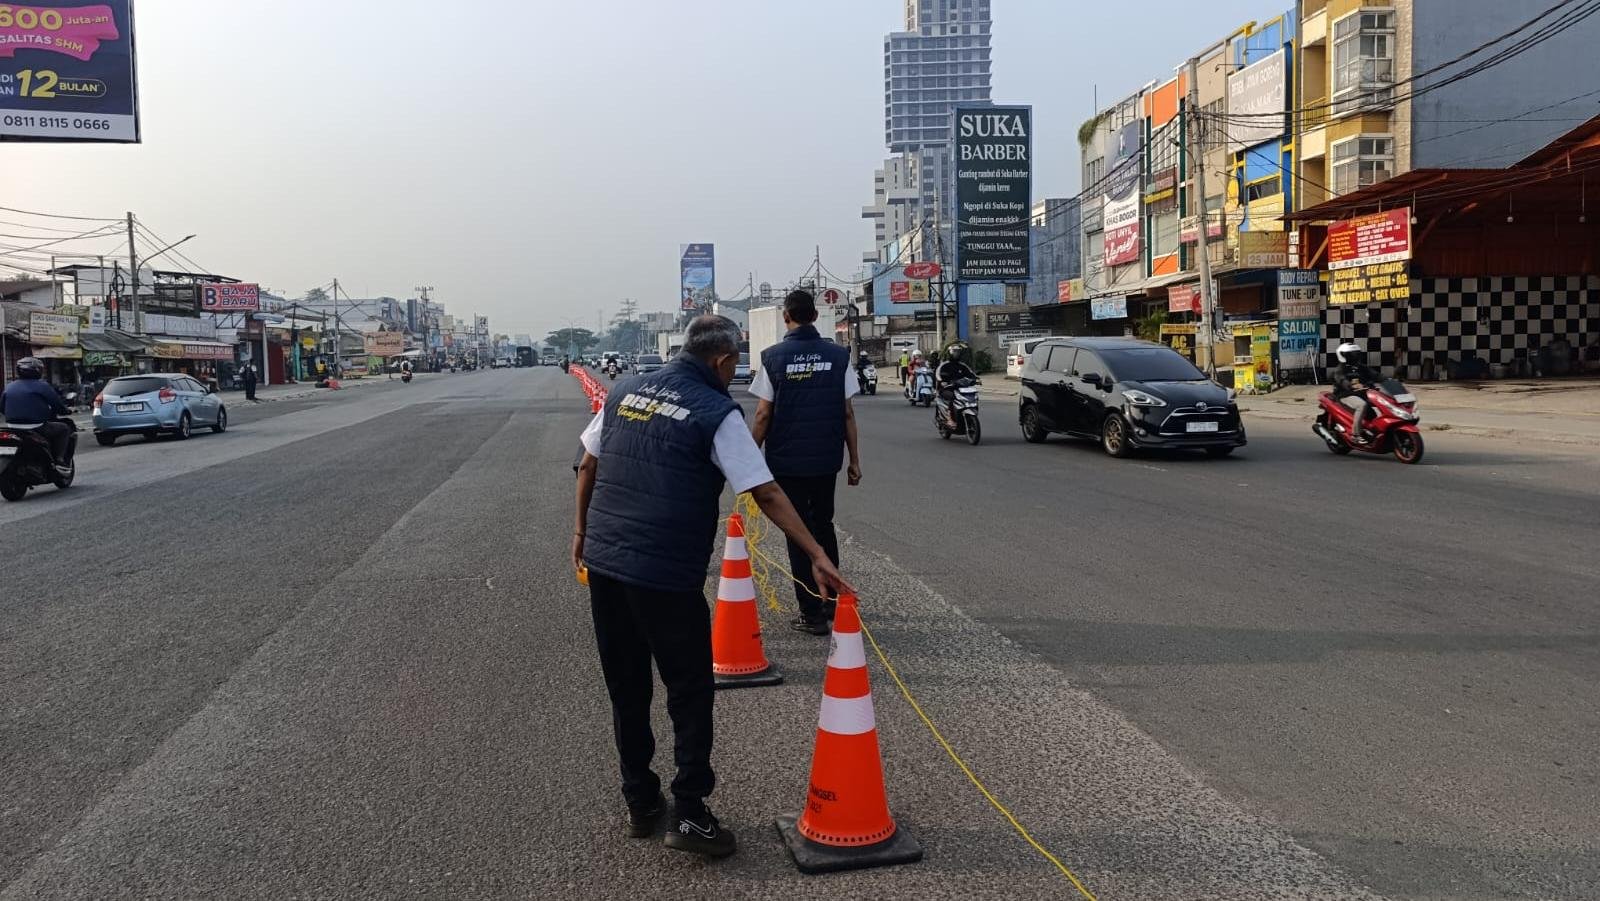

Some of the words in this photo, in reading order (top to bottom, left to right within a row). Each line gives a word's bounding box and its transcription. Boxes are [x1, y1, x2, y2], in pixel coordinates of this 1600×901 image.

[55, 38, 83, 52] SHM
[16, 69, 58, 98] 12
[59, 82, 98, 92] BULAN
[4, 115, 35, 127] 0811
[39, 117, 69, 129] 8115
[73, 119, 110, 130] 0666
[960, 114, 1026, 137] SUKA
[960, 144, 1026, 160] BARBER
[963, 202, 984, 211] Ngopi
[984, 202, 992, 210] di
[992, 202, 1009, 210] Suka
[1009, 202, 1025, 211] Kopi
[968, 216, 994, 225] dijamin
[1119, 209, 1137, 222] BOGOR
[1263, 253, 1285, 265] JAM
[983, 268, 998, 276] JAM
[1002, 267, 1026, 275] MALAM
[1280, 271, 1295, 283] BODY
[1296, 271, 1318, 283] REPAIR
[1396, 273, 1408, 286] AC
[205, 287, 217, 306] B
[222, 287, 256, 296] BAJA
[1282, 289, 1301, 300] TUNE
[1390, 286, 1410, 299] OVEN
[222, 297, 256, 306] BARU
[1282, 321, 1316, 334] SALON
[1171, 335, 1188, 349] AC
[1281, 338, 1297, 350] CAT
